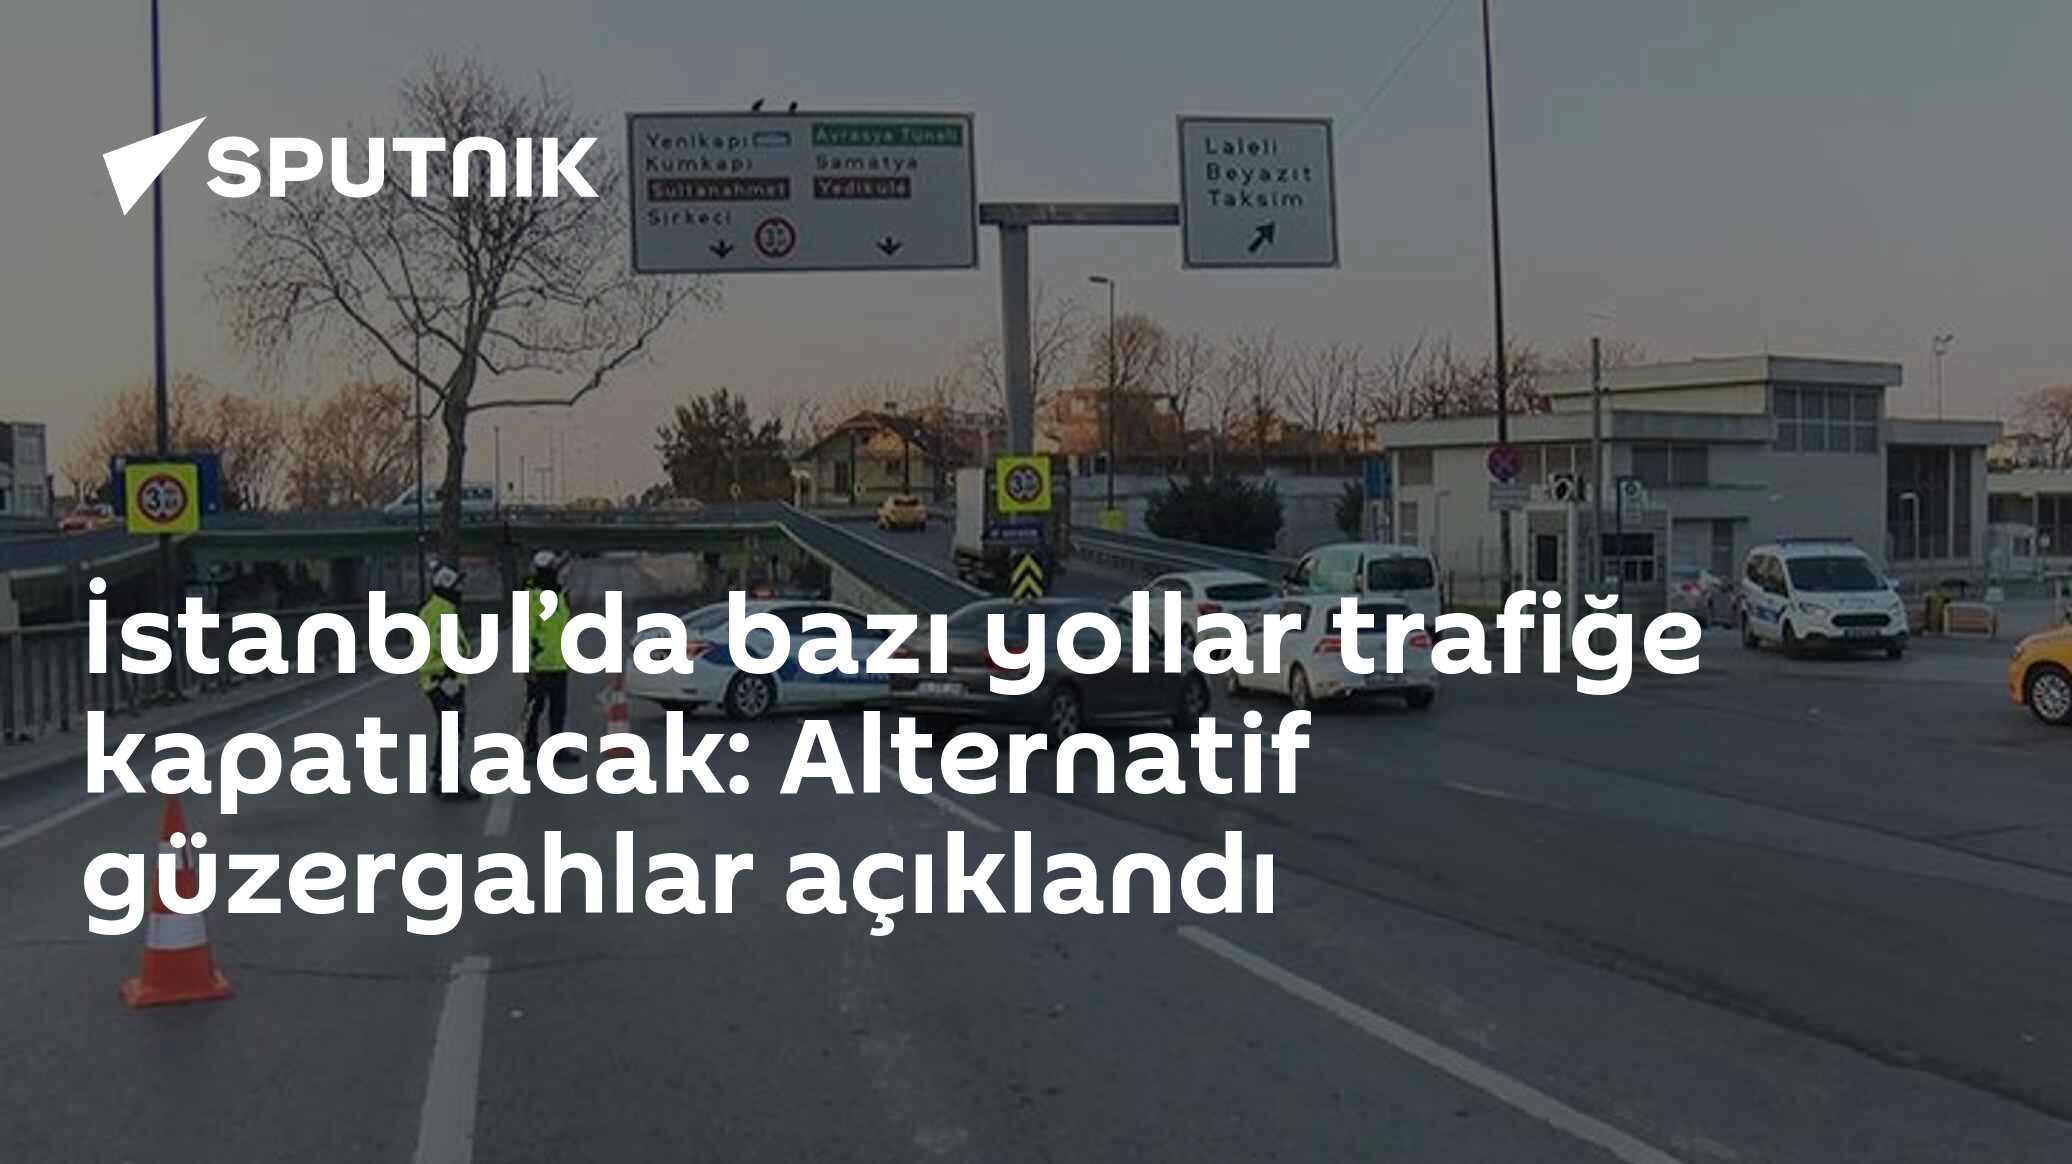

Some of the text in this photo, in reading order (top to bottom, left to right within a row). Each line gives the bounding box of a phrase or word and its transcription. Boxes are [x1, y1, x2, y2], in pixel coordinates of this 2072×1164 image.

[1205, 137, 1277, 155] Laleli
[816, 155, 918, 171] Samatya
[650, 180, 786, 198] Sultanahmet
[818, 180, 906, 196] Yedikule
[1207, 188, 1303, 208] Taksim
[648, 208, 731, 226] Sirkeci
